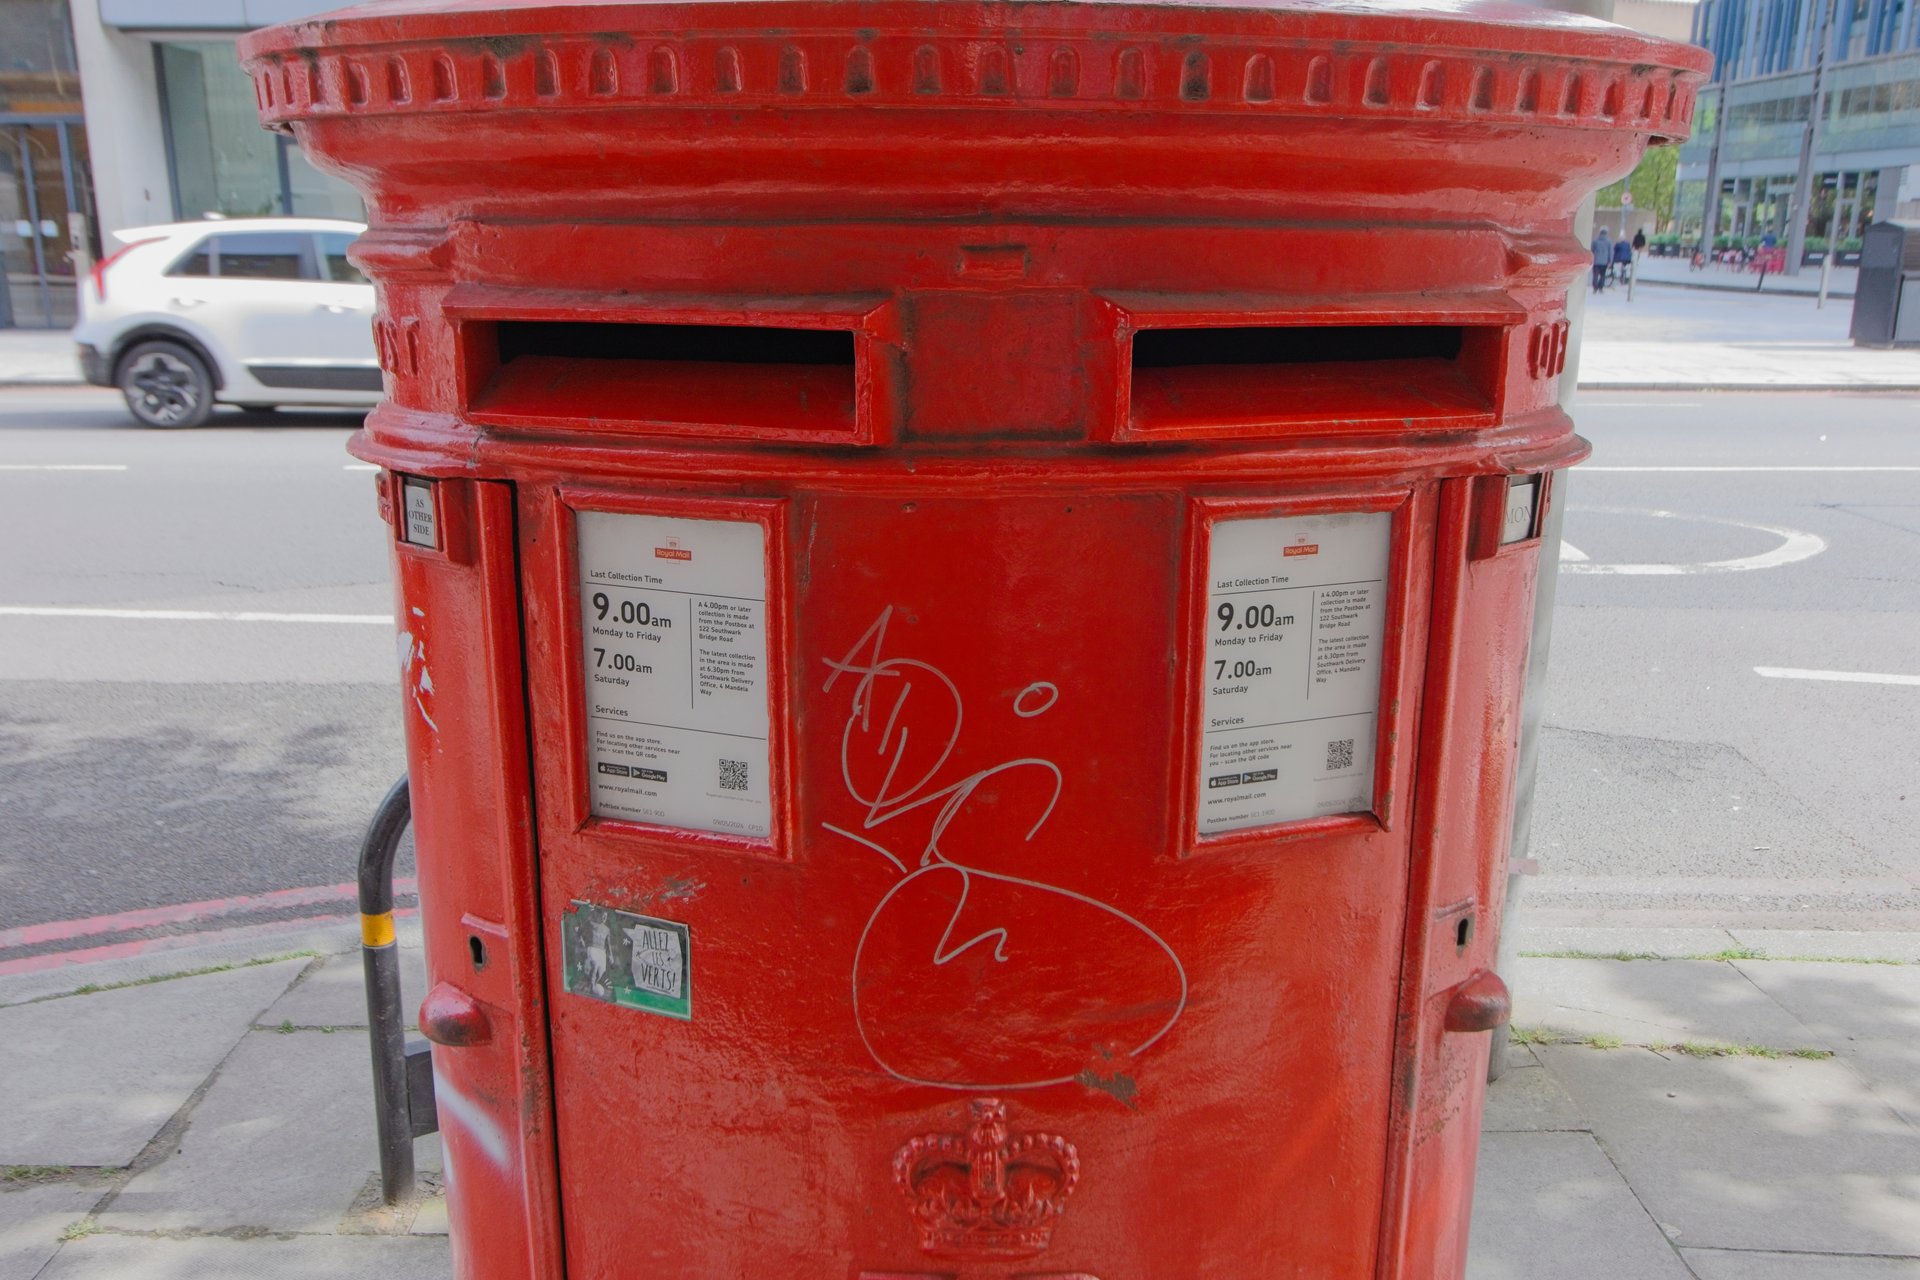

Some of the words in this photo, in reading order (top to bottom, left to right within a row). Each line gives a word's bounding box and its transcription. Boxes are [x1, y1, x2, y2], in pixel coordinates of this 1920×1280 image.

[416, 498, 424, 508] AS
[408, 510, 432, 523] OTHER
[413, 524, 430, 536] SIDE
[656, 549, 675, 558] Royal
[675, 550, 690, 559] Mail
[1284, 547, 1303, 555] Royal
[590, 570, 606, 578] Last
[608, 572, 643, 582] Collection
[644, 575, 663, 584] Time
[1234, 577, 1270, 587] Collection
[1326, 590, 1348, 598] 4.00pm
[704, 602, 728, 610] 4.00pm
[1320, 598, 1344, 606] collection
[593, 592, 672, 628] 9.00am
[698, 610, 726, 618] collection
[1218, 602, 1294, 632] 9.00am
[724, 620, 747, 628] Postbox
[592, 626, 624, 639] Monday
[626, 630, 634, 638] to
[636, 632, 662, 643] Friday
[712, 627, 742, 636] Southwark
[699, 634, 718, 642] Bridge
[1215, 637, 1246, 646] Monday
[1259, 634, 1284, 642] Friday
[1345, 634, 1370, 642] collection
[712, 650, 728, 658] latest
[728, 652, 756, 660] collection
[594, 648, 652, 674] 7.00am
[1317, 660, 1344, 668] Southwark
[706, 666, 730, 674] 6.30pm
[1214, 660, 1272, 680] 7.00am
[594, 674, 630, 687] Saturday
[700, 673, 730, 682] Southwark
[731, 677, 754, 686] Delivery
[700, 681, 718, 689] Office,
[724, 684, 749, 692] Mandela
[1212, 685, 1248, 696] Saturday
[596, 704, 628, 716] Services
[1211, 716, 1244, 727] Services
[596, 731, 608, 739] Find
[625, 734, 634, 742] the
[636, 736, 646, 744] app
[606, 739, 628, 748] locating
[629, 742, 644, 750] other
[645, 744, 666, 753] services
[1249, 740, 1259, 748] app
[626, 748, 634, 756] the
[644, 752, 658, 760] code
[1220, 750, 1241, 758] locating
[598, 784, 658, 798] www.royalmail.com
[1208, 792, 1266, 805] www.royalmail.com
[620, 806, 642, 814] number
[642, 929, 669, 952] ALLEZ
[652, 952, 664, 966] LES
[641, 963, 676, 993] VERTS!
